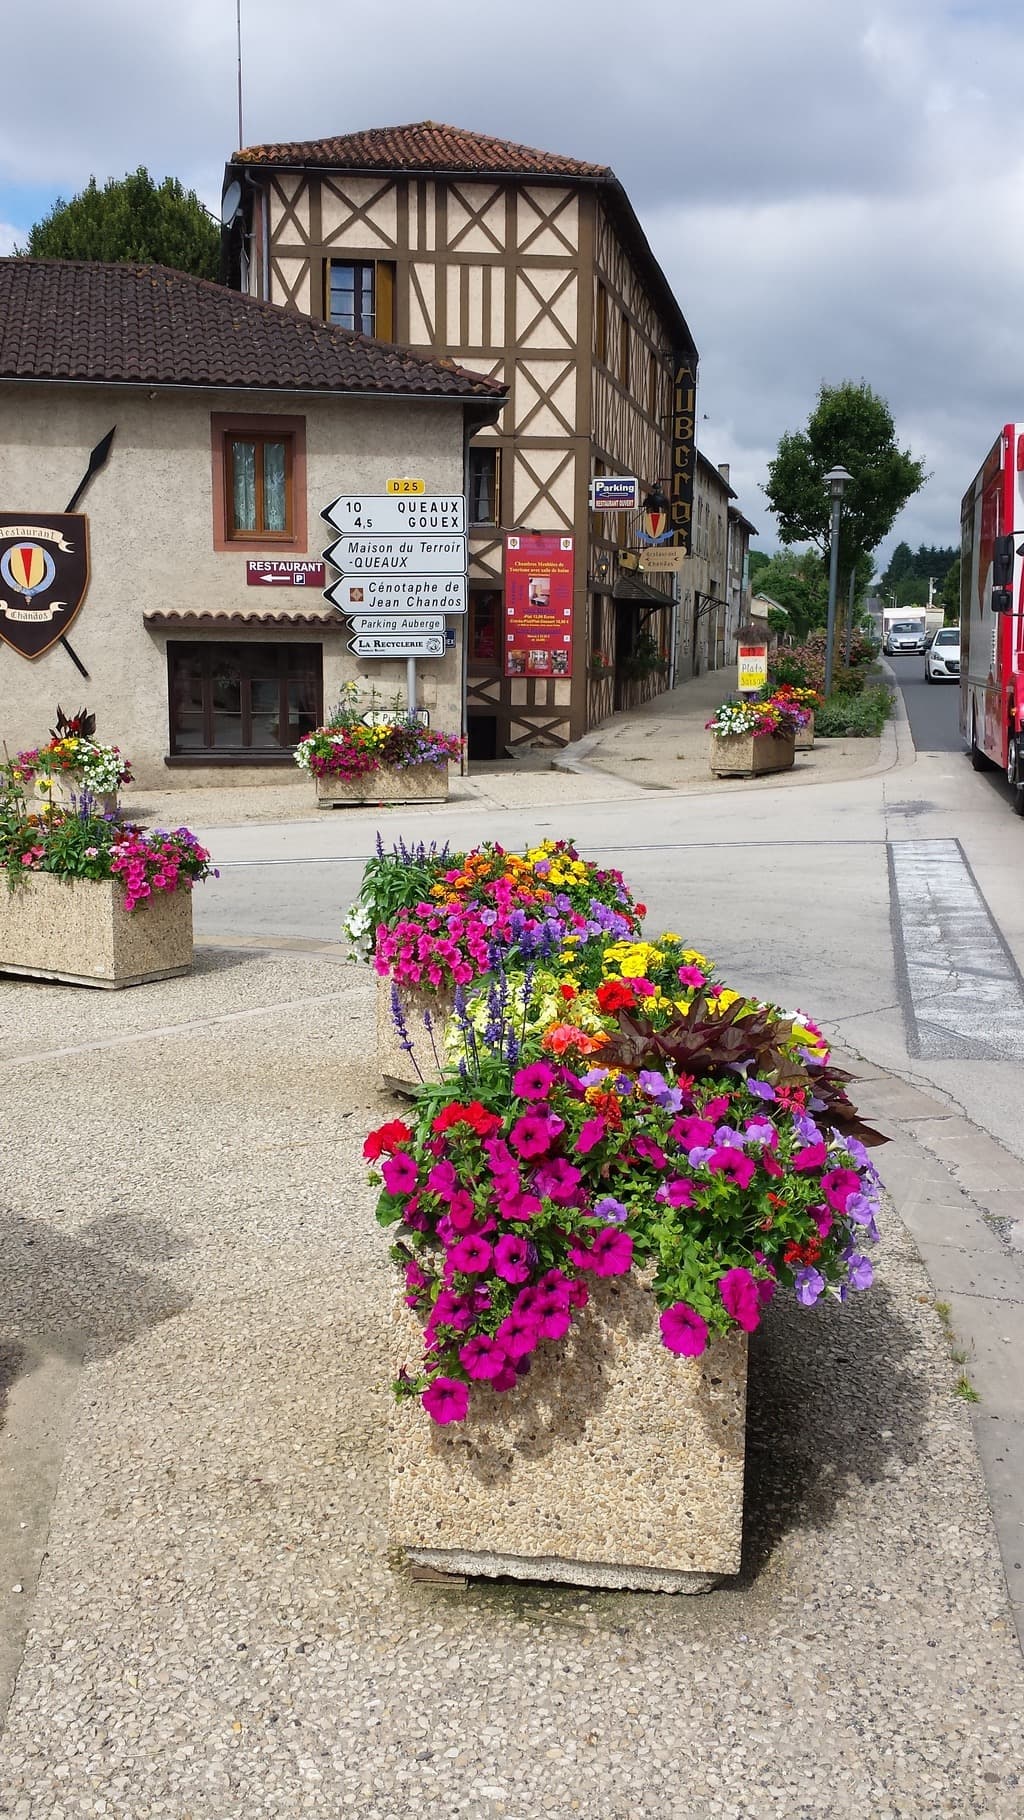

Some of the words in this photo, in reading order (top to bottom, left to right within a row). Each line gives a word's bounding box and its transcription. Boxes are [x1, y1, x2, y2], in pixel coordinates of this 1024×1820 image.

[393, 482, 400, 491] D
[403, 482, 418, 491] 25
[595, 482, 635, 493] Parking
[346, 502, 362, 513] 10
[397, 502, 459, 514] QUEAUX
[353, 517, 373, 529] 4,5
[408, 517, 459, 528] GOUEX
[348, 542, 393, 553] Maison
[399, 542, 413, 553] du
[420, 542, 461, 553] Terroir
[249, 561, 323, 572] RESTAURANT
[368, 582, 438, 595] Cénotaphe
[445, 582, 459, 592] de
[369, 597, 399, 607] Jean
[406, 596, 462, 607] Chandos
[10, 611, 49, 620] Chandos
[361, 620, 397, 630] Parking
[402, 619, 440, 630] Auberge
[359, 640, 371, 648] LA
[373, 640, 424, 648] RECYCLERIE
